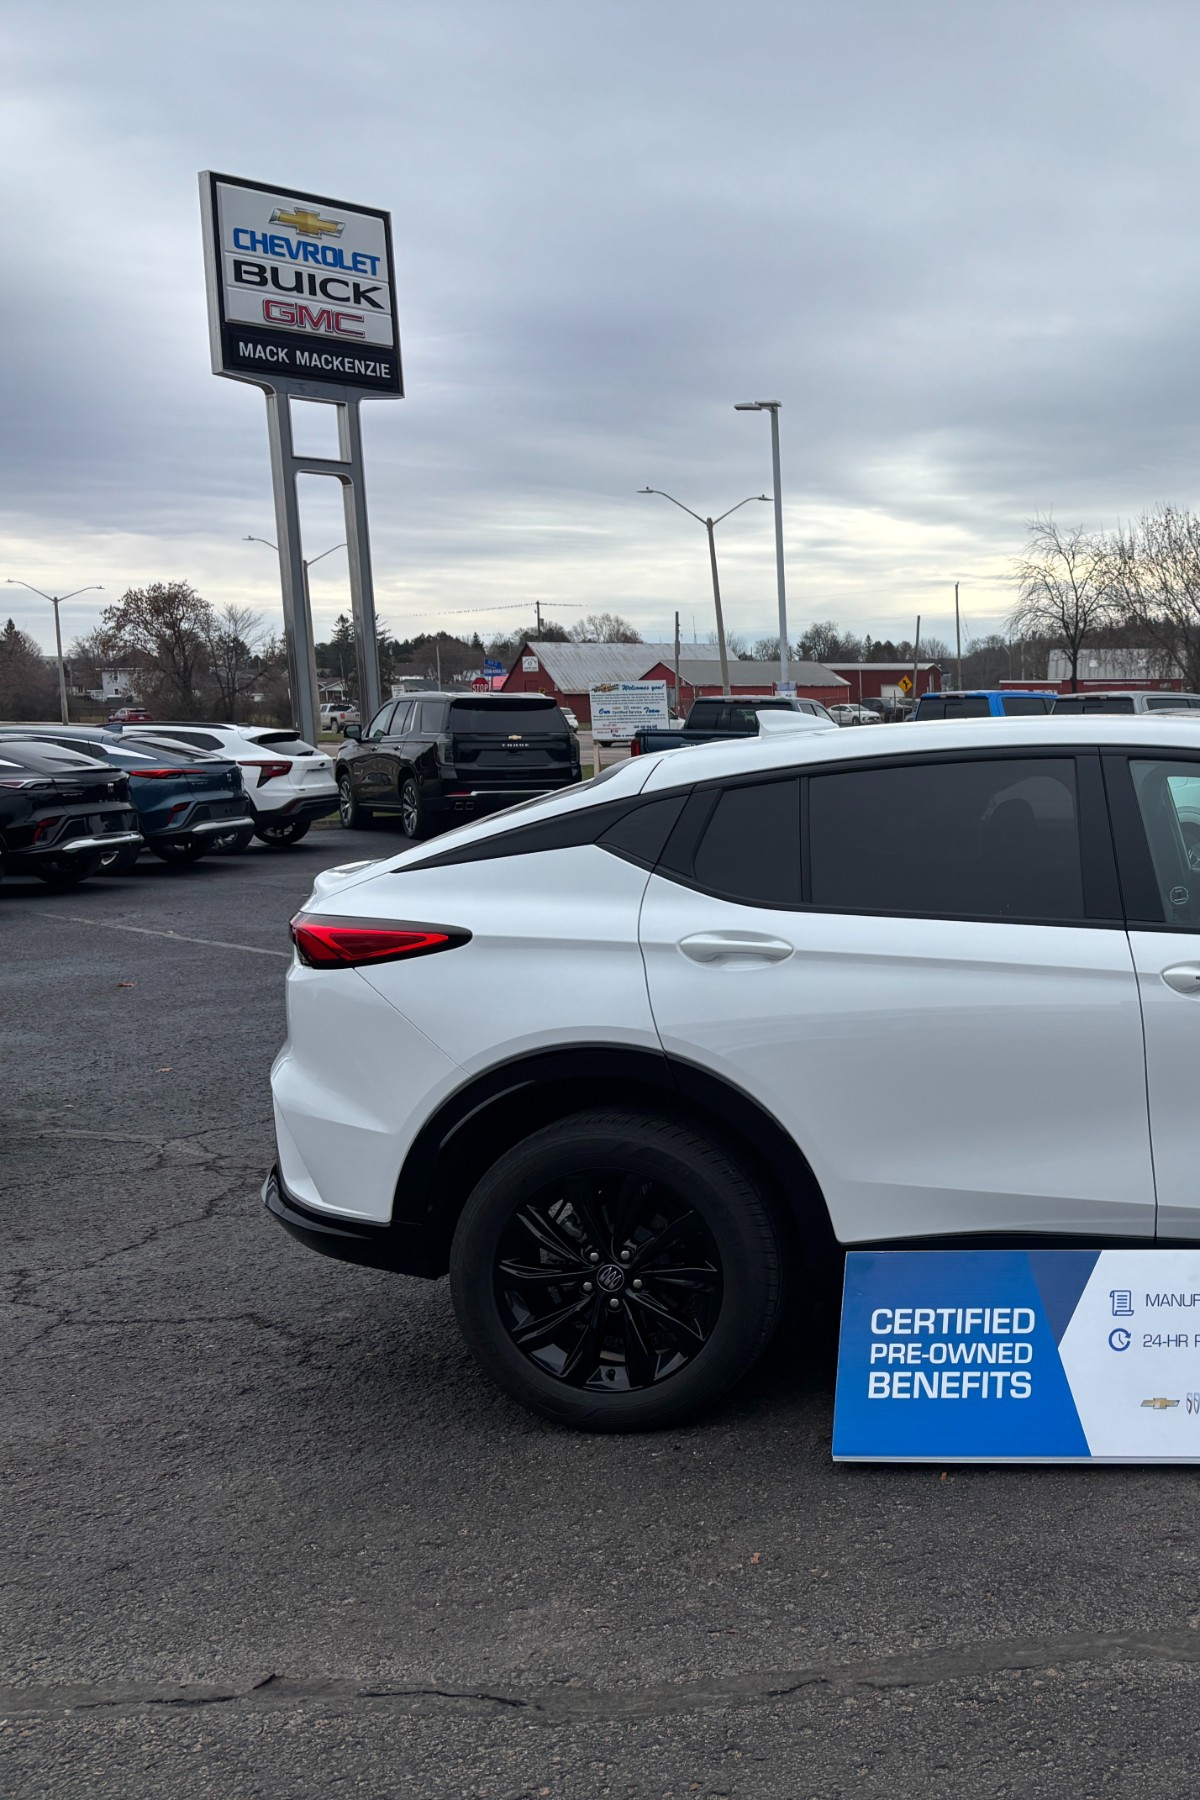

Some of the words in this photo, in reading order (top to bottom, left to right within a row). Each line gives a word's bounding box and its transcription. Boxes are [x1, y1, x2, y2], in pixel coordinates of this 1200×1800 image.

[233, 227, 381, 276] CHEVROLET
[233, 259, 385, 310] BUICK
[263, 298, 366, 338] GMC
[239, 341, 290, 364] MACK
[295, 350, 391, 378] MACKENZIE
[472, 683, 489, 693] STOP
[651, 683, 665, 692] you!
[870, 1307, 1036, 1335] CERTIFIED
[870, 1342, 1033, 1365] PRE-OWNED
[1142, 1333, 1189, 1348] 24-HR
[867, 1371, 1032, 1399] BENEFITS
